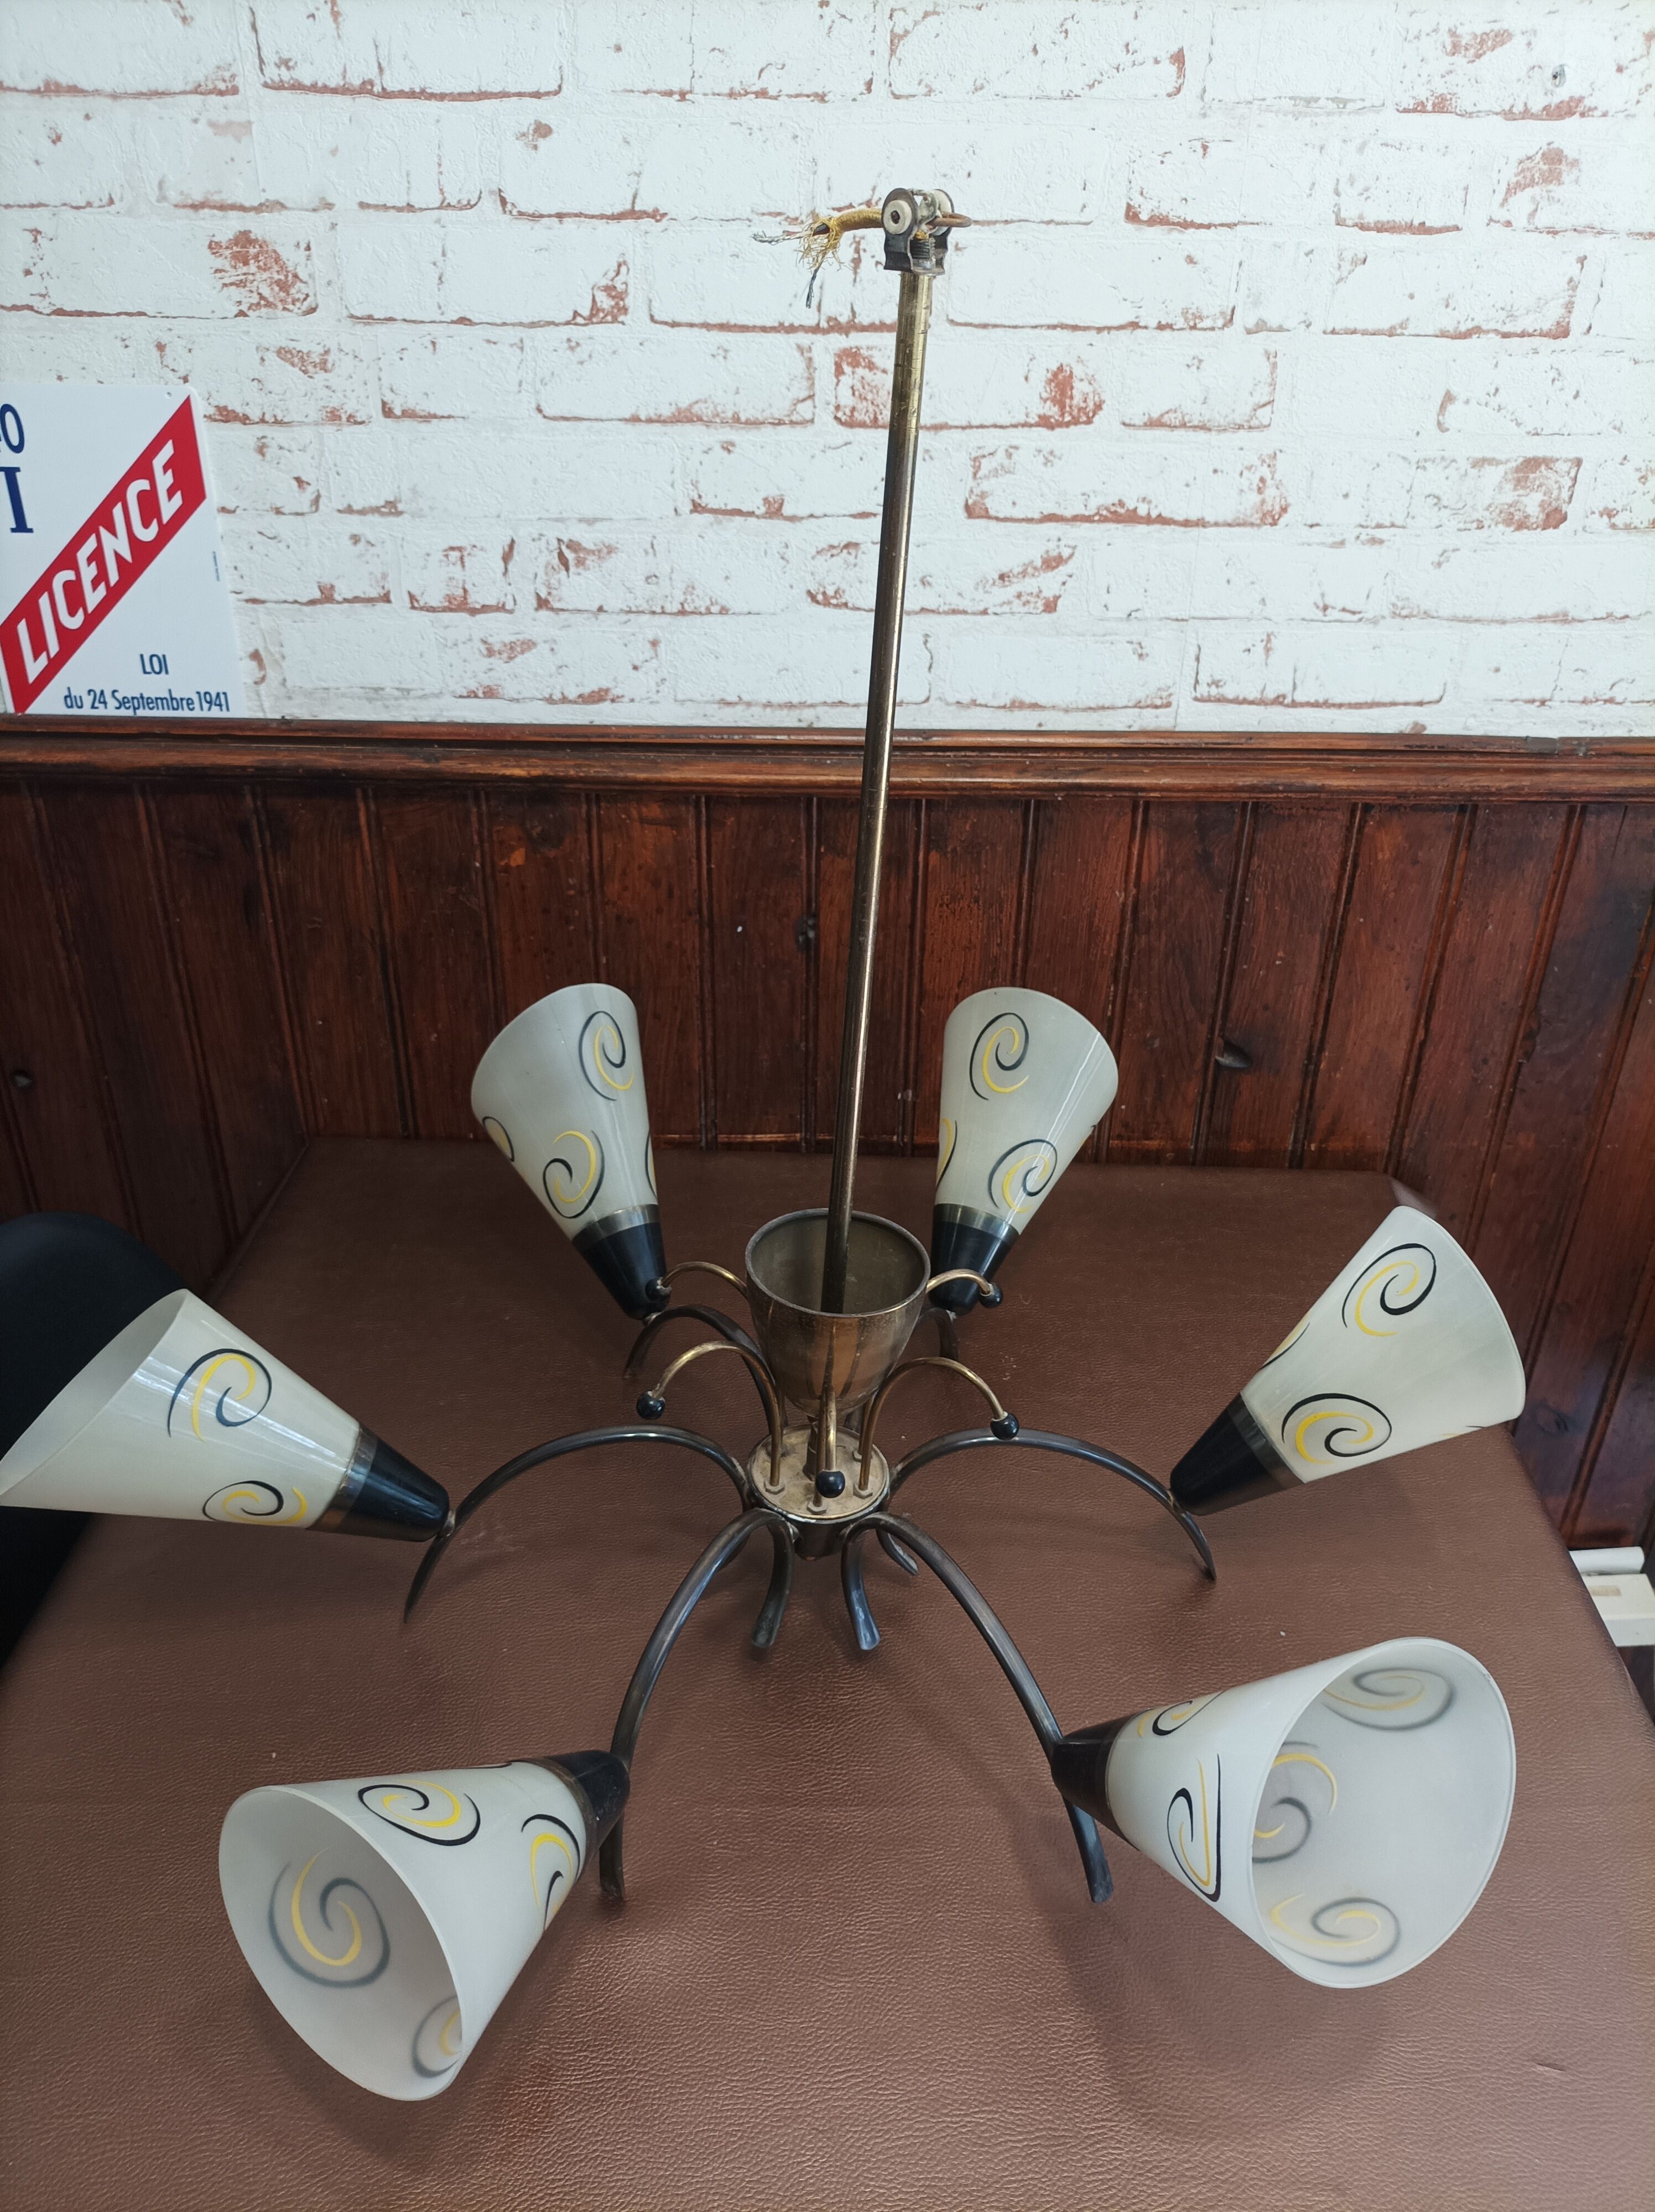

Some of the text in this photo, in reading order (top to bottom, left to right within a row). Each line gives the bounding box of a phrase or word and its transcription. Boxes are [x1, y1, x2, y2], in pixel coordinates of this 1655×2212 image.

[17, 439, 183, 684] LICENCE
[140, 653, 169, 675] LOI
[64, 686, 230, 716] du 24 Septembre 1941
